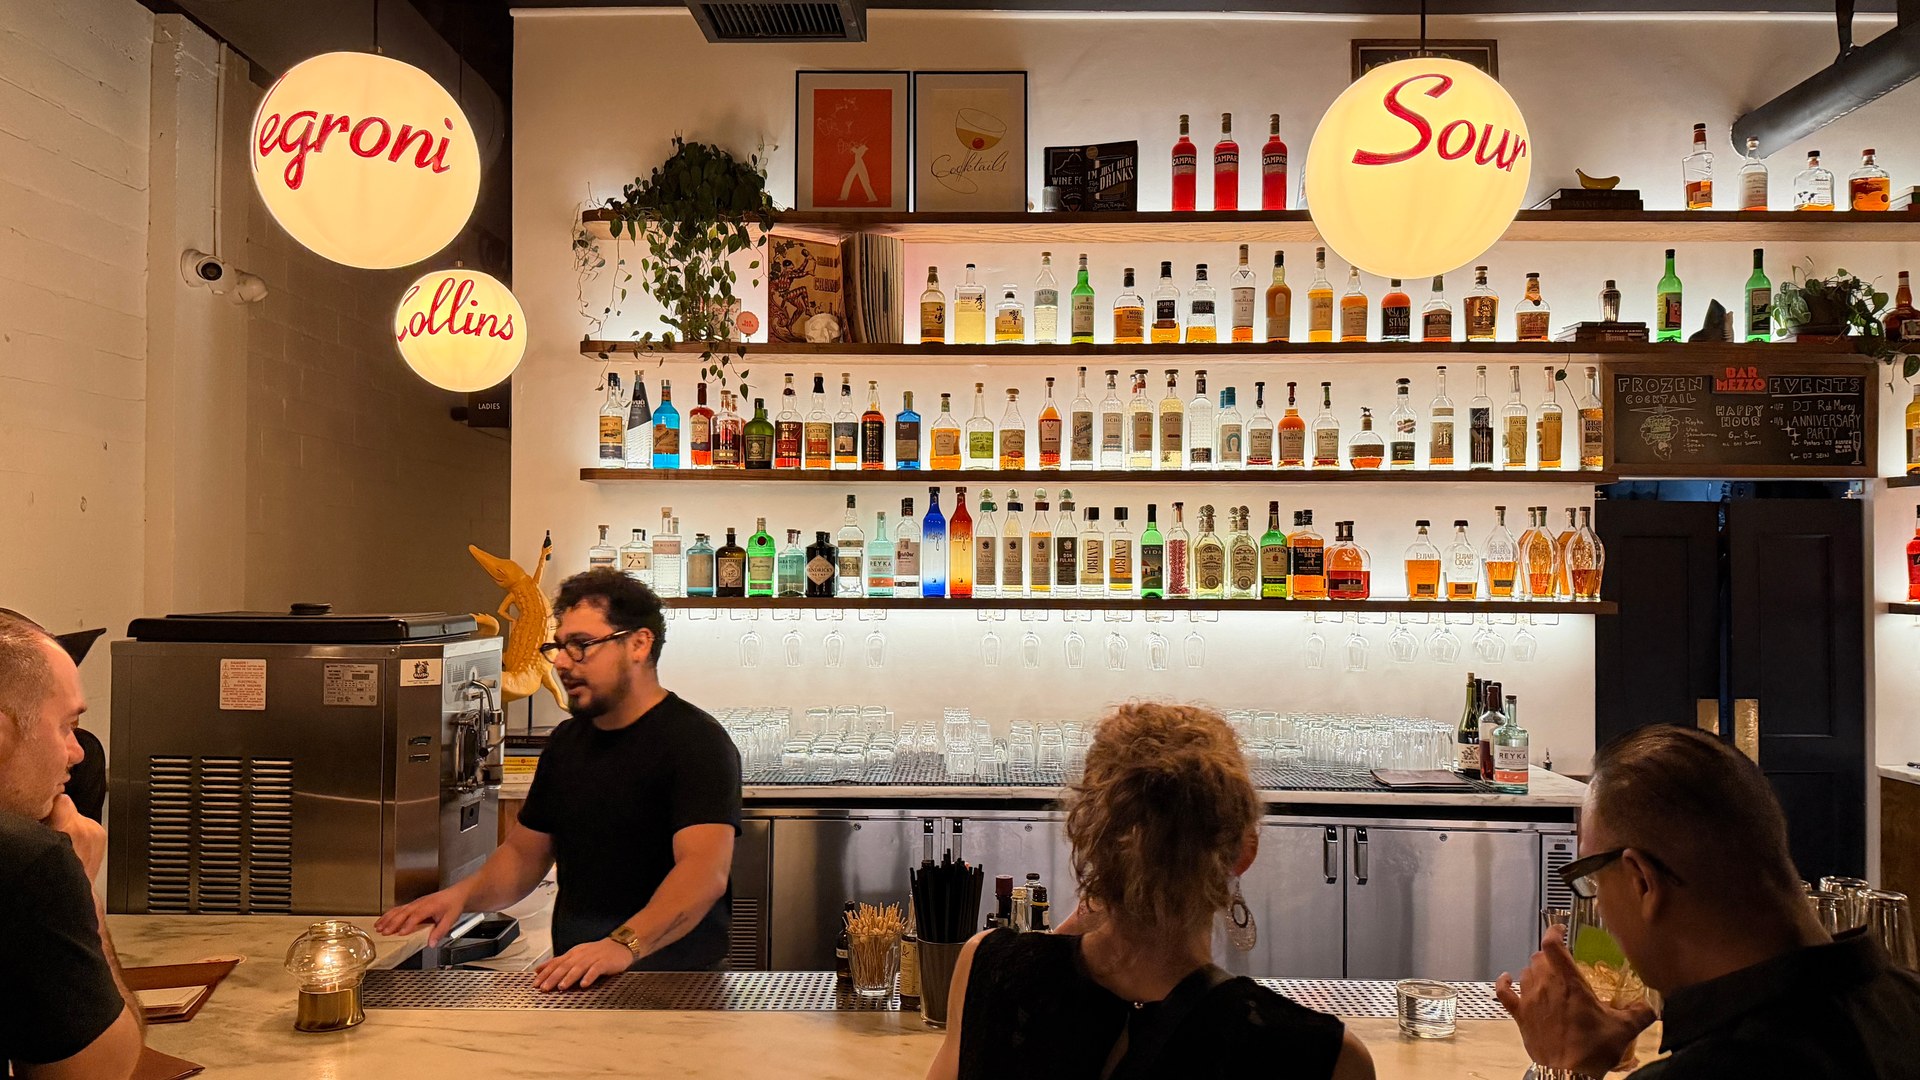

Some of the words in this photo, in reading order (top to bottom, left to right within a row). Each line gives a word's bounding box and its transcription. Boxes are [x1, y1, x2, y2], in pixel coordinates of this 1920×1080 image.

[1352, 73, 1527, 172] Sour
[255, 72, 453, 190] egroni
[931, 150, 1008, 179] Cocktails
[1052, 176, 1073, 186] WINE
[1100, 167, 1134, 191] DRINKS
[1726, 367, 1757, 378] BAR
[1618, 377, 1703, 393] FROZEN
[1716, 378, 1766, 391] MEZZO
[1769, 378, 1860, 393] EVENTS
[1626, 393, 1696, 404] COCKTAIL
[1793, 401, 1812, 411] DJ
[1716, 405, 1764, 416] HAPPY
[1721, 417, 1760, 427] HOUR
[1791, 414, 1861, 430] ANNIVERSARY
[1807, 427, 1838, 439] PARTY
[1087, 539, 1098, 573] CAMBIO
[1114, 539, 1126, 573] CAMBIO
